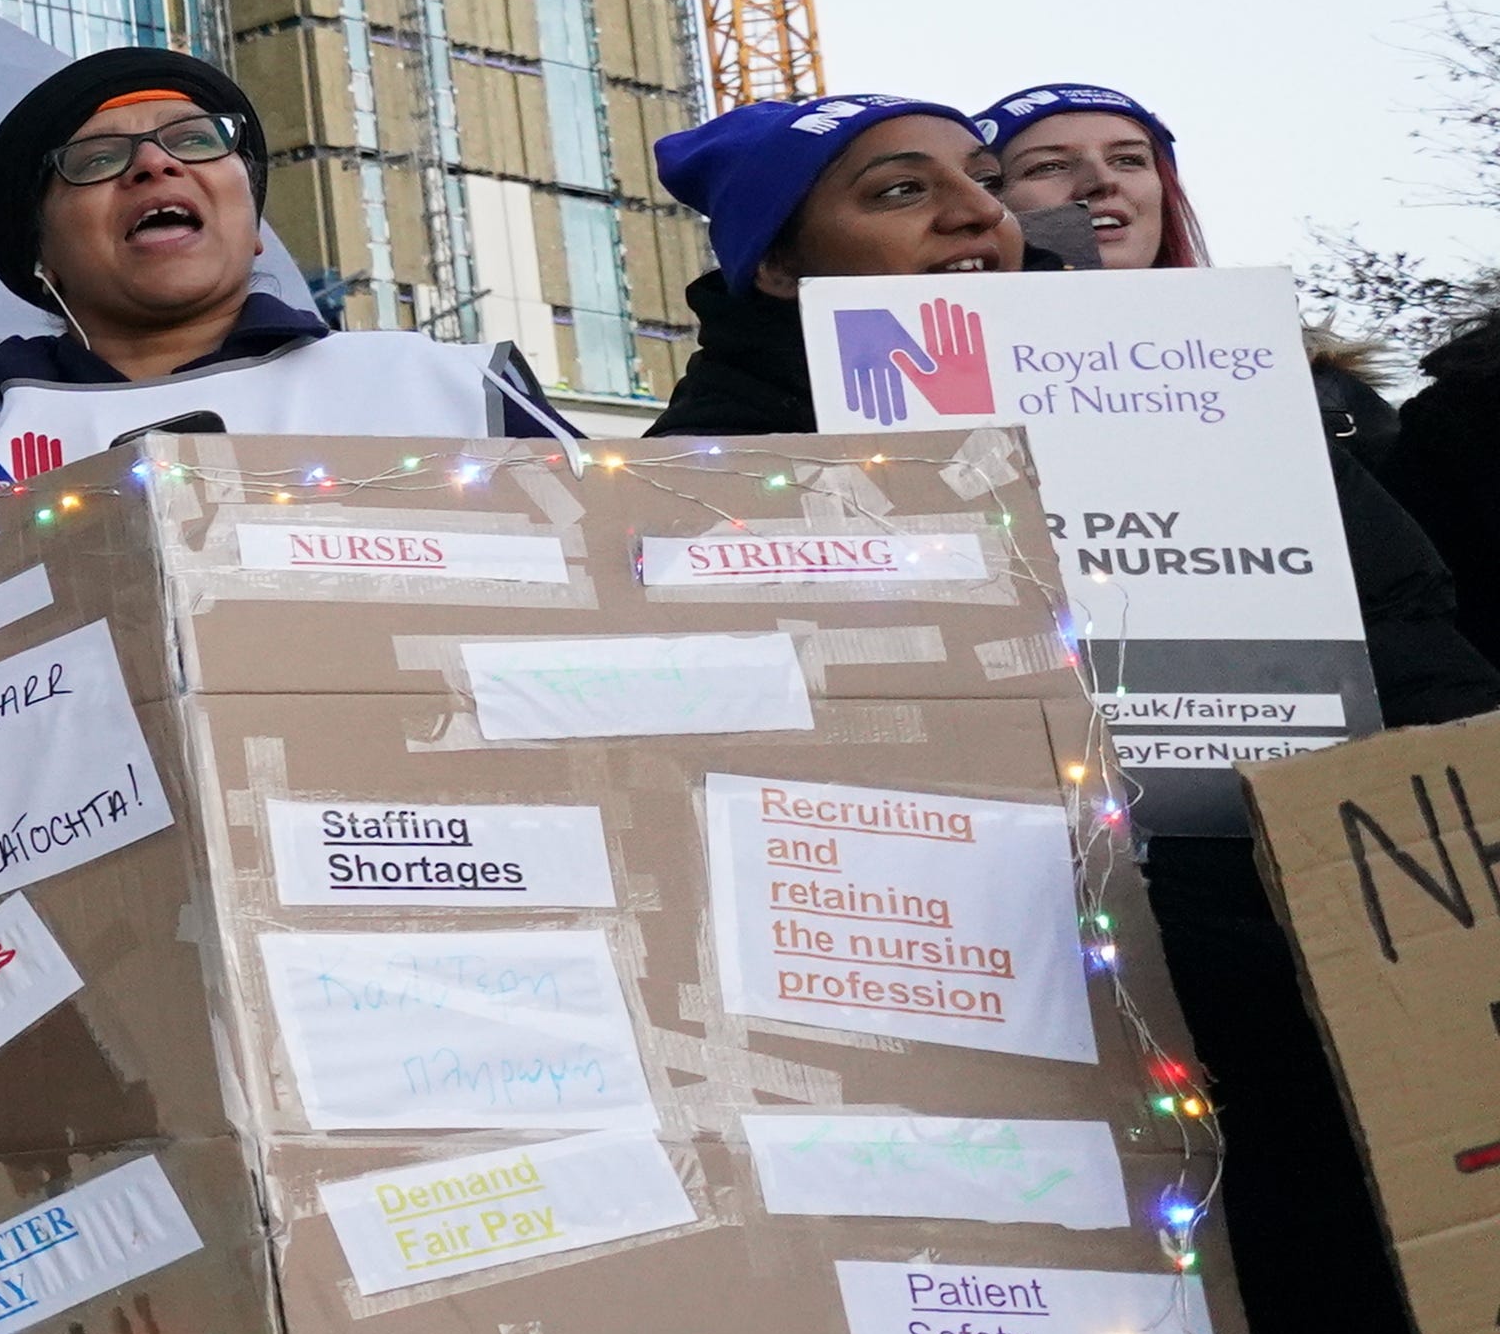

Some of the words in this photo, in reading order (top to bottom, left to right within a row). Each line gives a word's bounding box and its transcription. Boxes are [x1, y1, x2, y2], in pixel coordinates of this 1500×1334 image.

[1012, 340, 1119, 384] Royal
[1129, 338, 1276, 381] College
[1019, 384, 1059, 415] of
[1071, 384, 1226, 424] Nursing
[1083, 511, 1180, 539] PAY
[288, 532, 445, 565] NURSES
[687, 538, 894, 572] STRIKING
[1077, 546, 1314, 576] NURSING
[1100, 697, 1297, 729] g.uk/fairpay
[1118, 737, 1316, 764] ayForNursin
[321, 809, 471, 843] Staffing
[760, 786, 975, 838] Recruiting
[765, 837, 839, 866] and
[328, 853, 524, 890] Shortages
[770, 877, 952, 925] retaining
[773, 919, 834, 954] the
[849, 931, 1014, 975] nursing
[778, 970, 1003, 1015] profession
[375, 1154, 540, 1216] Demand
[395, 1218, 472, 1264] Fair
[479, 1203, 560, 1241] Pay
[906, 1272, 1049, 1311] Patient
